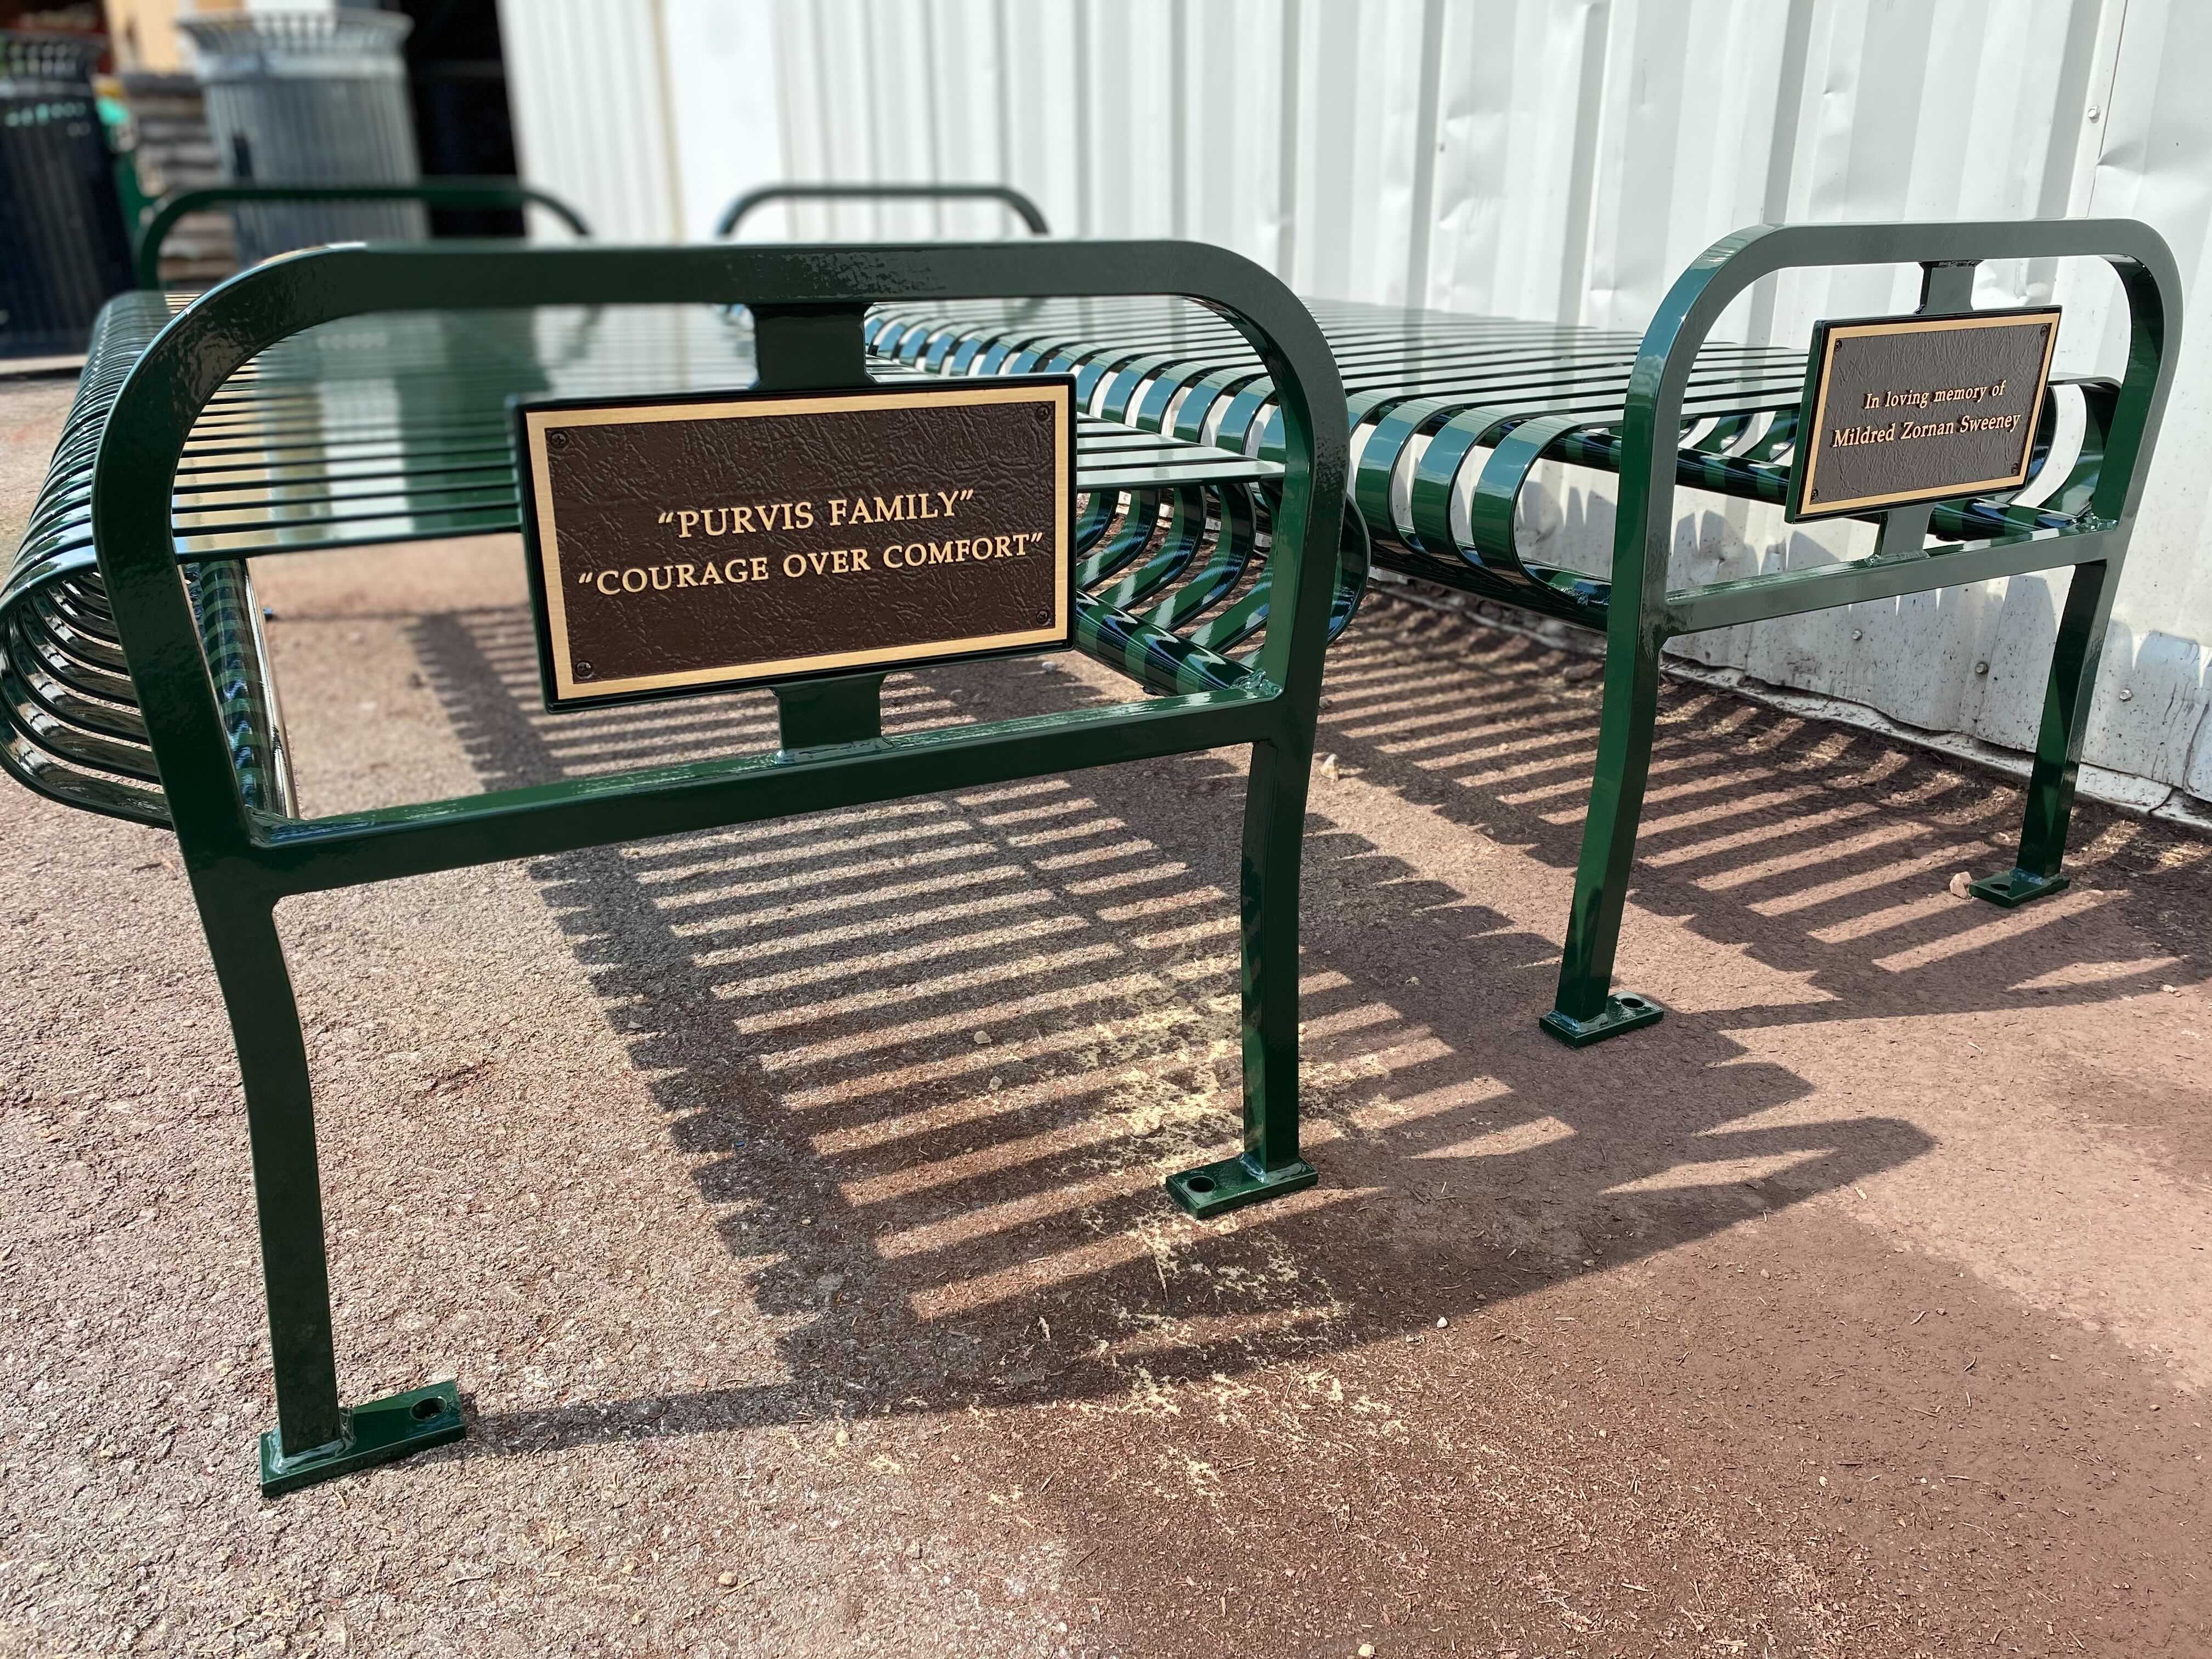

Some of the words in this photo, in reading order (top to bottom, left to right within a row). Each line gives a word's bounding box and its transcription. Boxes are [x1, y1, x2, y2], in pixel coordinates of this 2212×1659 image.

[1864, 393, 1880, 410] In
[1884, 389, 1929, 409] loving
[1933, 386, 1987, 403] memory
[1991, 380, 2007, 397] of
[1832, 422, 1895, 448] Mildred
[1900, 420, 1954, 440] Zornan
[1960, 414, 2021, 433] Sweeney
[657, 501, 815, 538] “PURVIS
[828, 488, 974, 527] FAMILY”
[578, 557, 769, 596] “COURAGE
[782, 549, 871, 578] OVER
[882, 531, 1043, 569] COMFORT”
